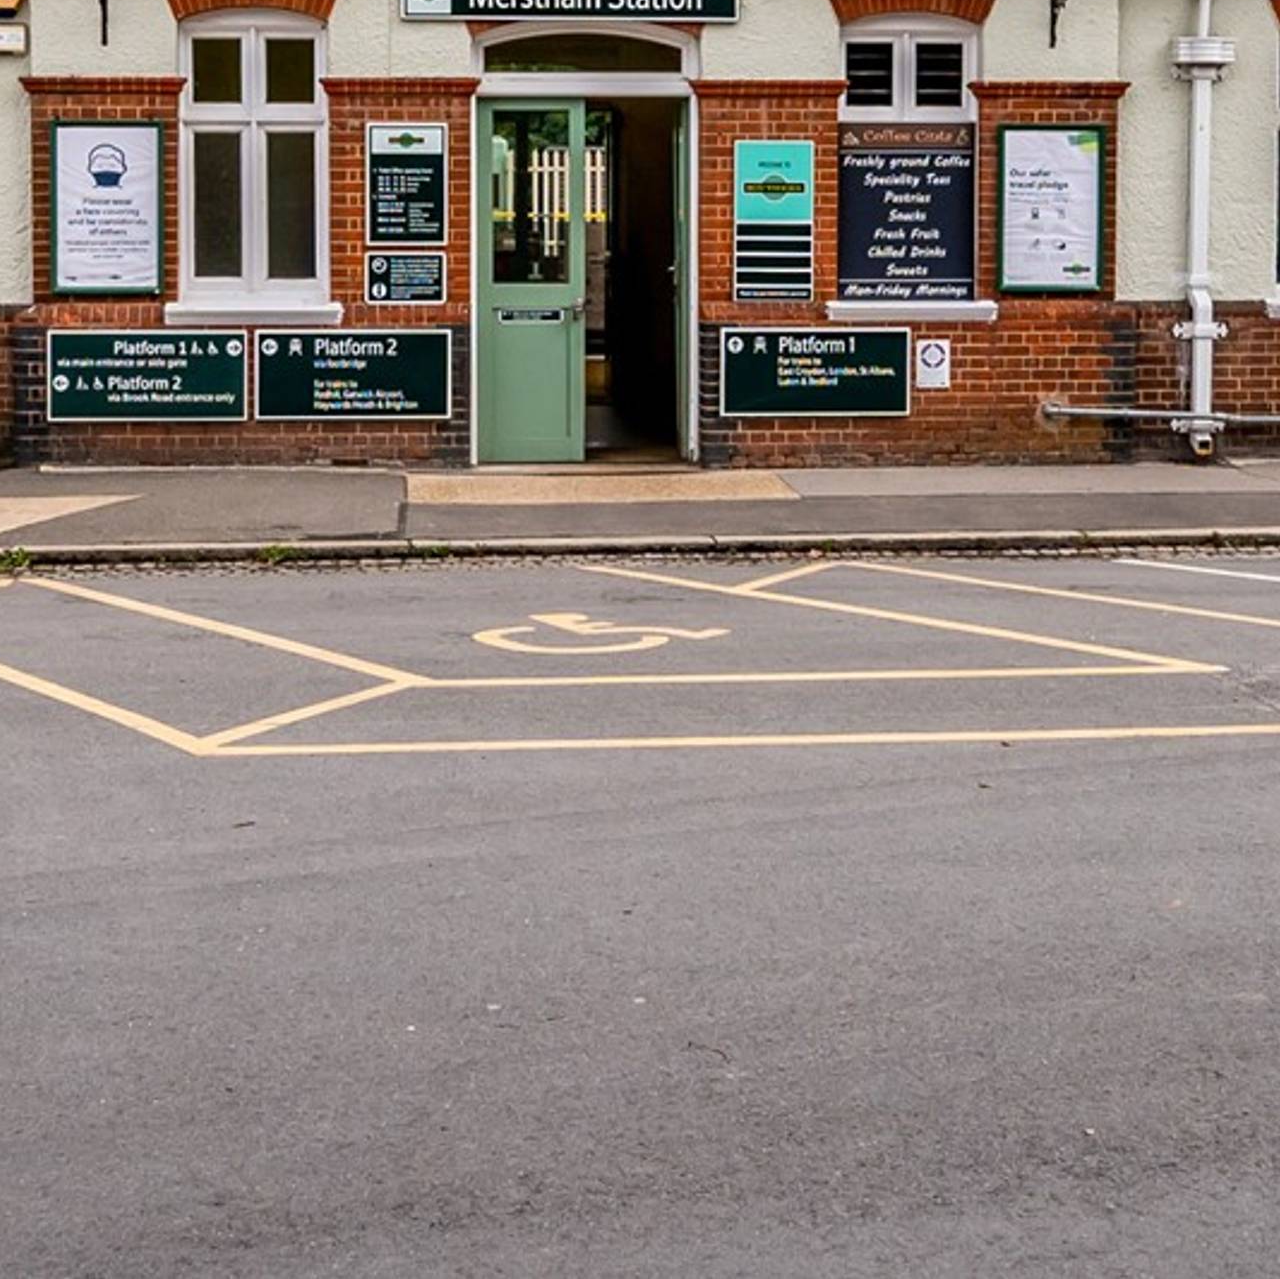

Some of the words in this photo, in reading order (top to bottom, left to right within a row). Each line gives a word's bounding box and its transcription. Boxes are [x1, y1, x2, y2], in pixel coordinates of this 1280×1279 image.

[843, 155, 885, 169] Freshly
[889, 155, 930, 170] ground
[934, 155, 970, 167] Coffee
[926, 173, 951, 185] Teas
[883, 190, 931, 203] Pastries
[888, 209, 927, 222] Snacks
[873, 227, 905, 239] Fresh
[910, 227, 940, 239] Fruit
[868, 245, 907, 258] Chilled
[910, 245, 947, 258] Drinks
[886, 263, 929, 277] Sweets
[916, 283, 968, 298] Mornings
[113, 340, 175, 355] Platform
[179, 341, 187, 355] 1
[314, 338, 384, 355] Platform
[386, 338, 398, 356] 2
[778, 336, 845, 353] Platform
[849, 336, 856, 353] 1
[57, 358, 70, 367] via
[72, 358, 94, 367] main
[96, 359, 134, 367] entrance
[136, 359, 145, 367] or
[148, 358, 166, 367] side
[107, 374, 169, 390] Platform
[172, 375, 182, 390] 2
[107, 393, 120, 402] via
[176, 394, 213, 402] entrance
[215, 393, 235, 404] only
